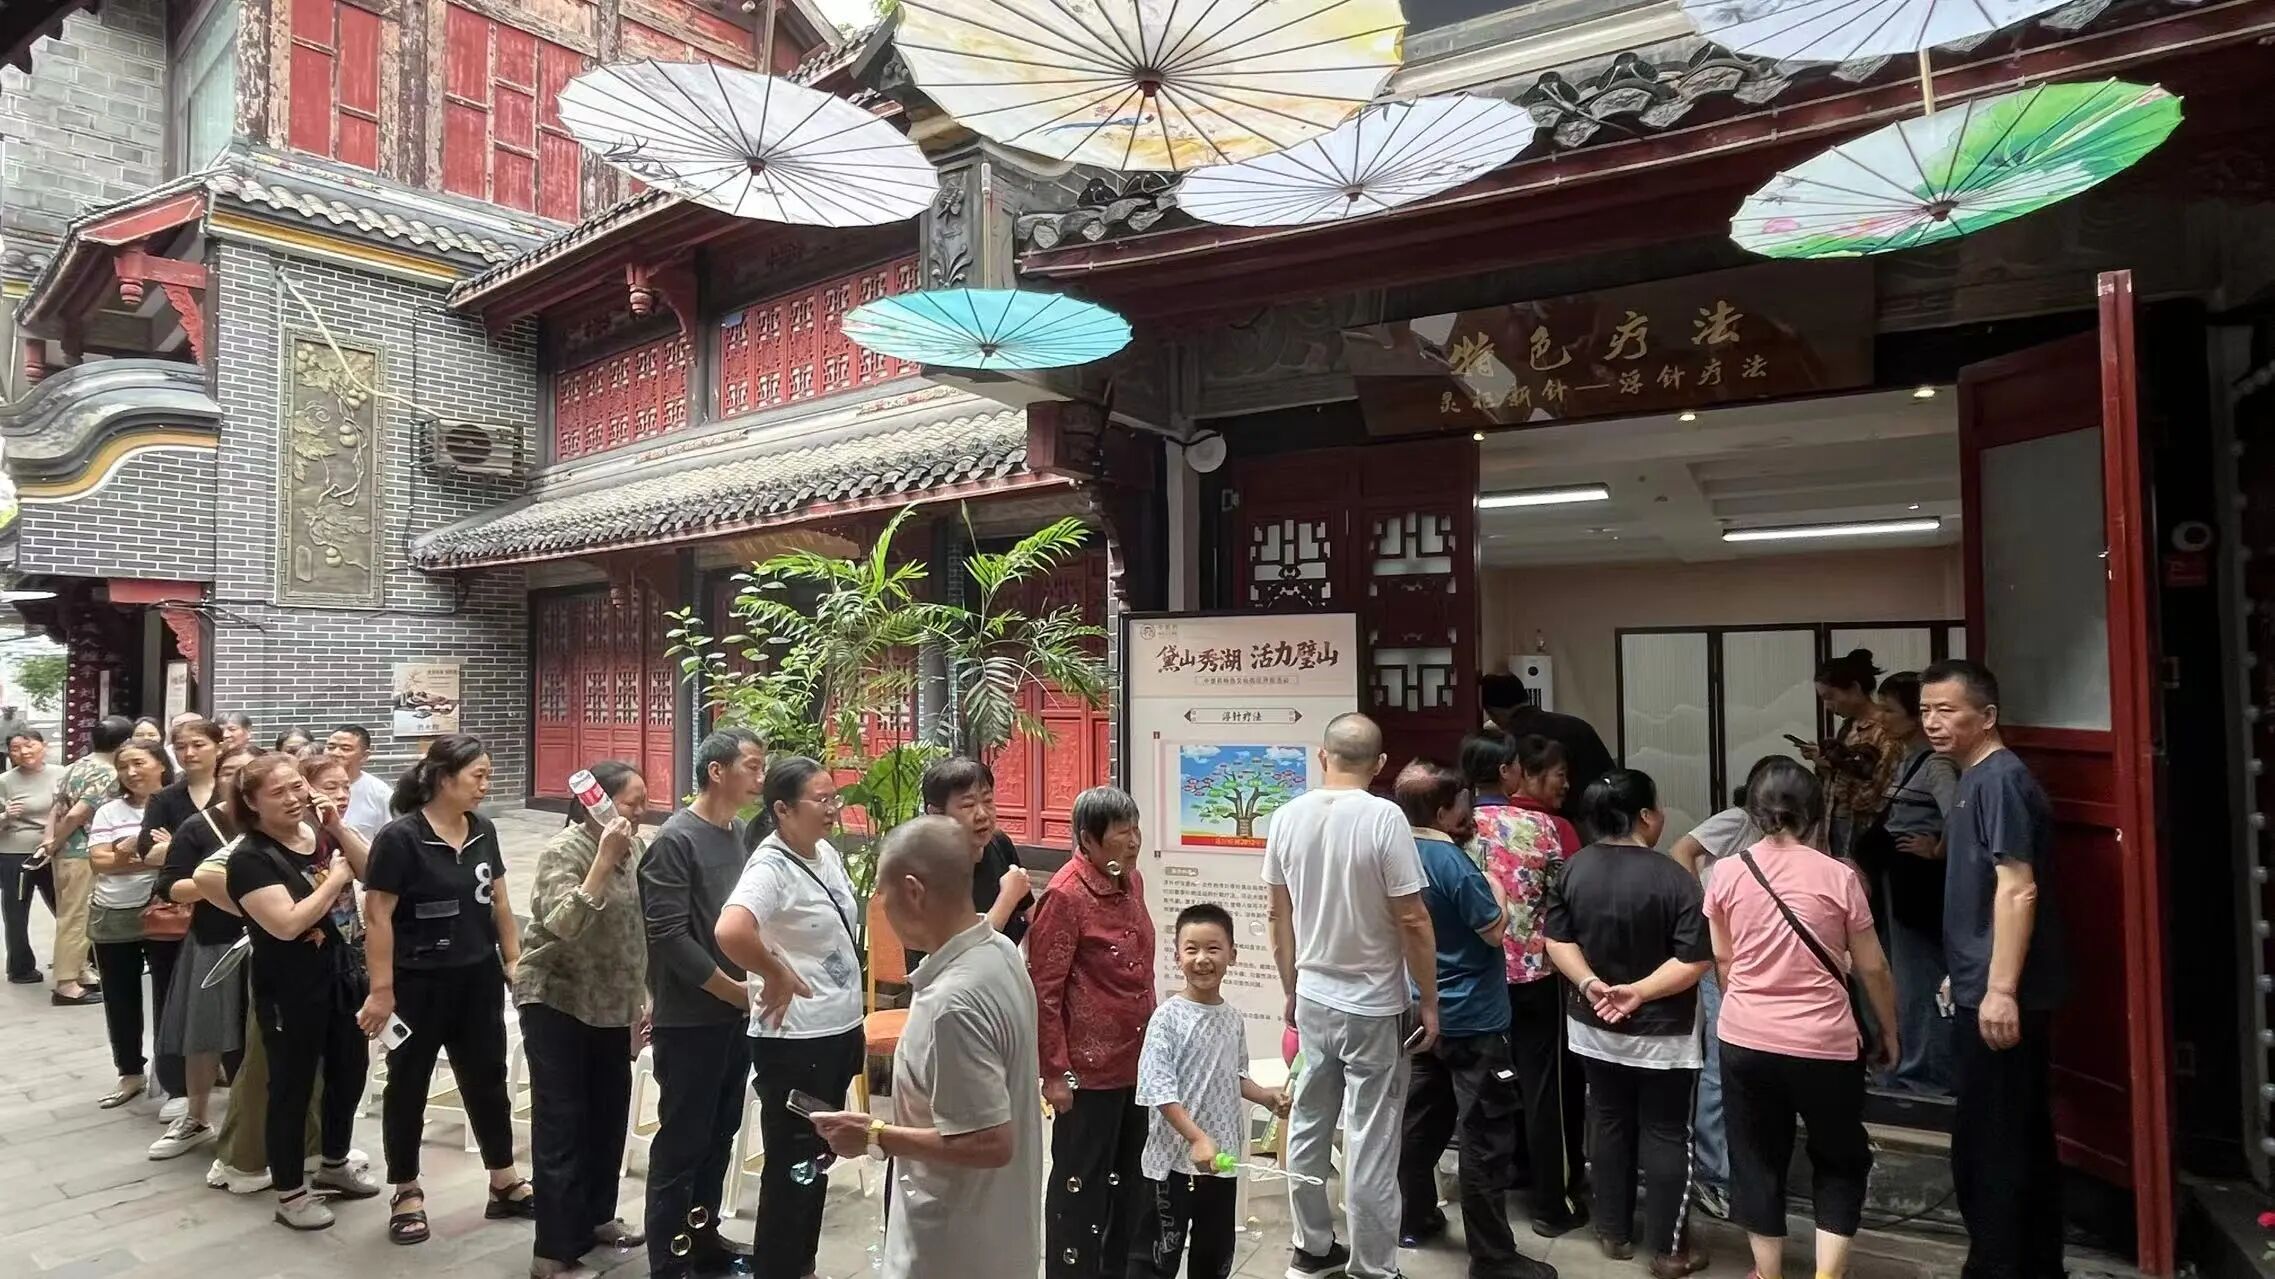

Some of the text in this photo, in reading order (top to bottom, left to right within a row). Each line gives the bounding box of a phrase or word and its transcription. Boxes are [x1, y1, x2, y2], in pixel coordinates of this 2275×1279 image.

[1448, 299, 1743, 377] 特色疗法
[1156, 639, 1339, 674] 黛山秀湖 活力璧山
[1222, 711, 1262, 722] 浮针疗法
[474, 862, 494, 905] 8
